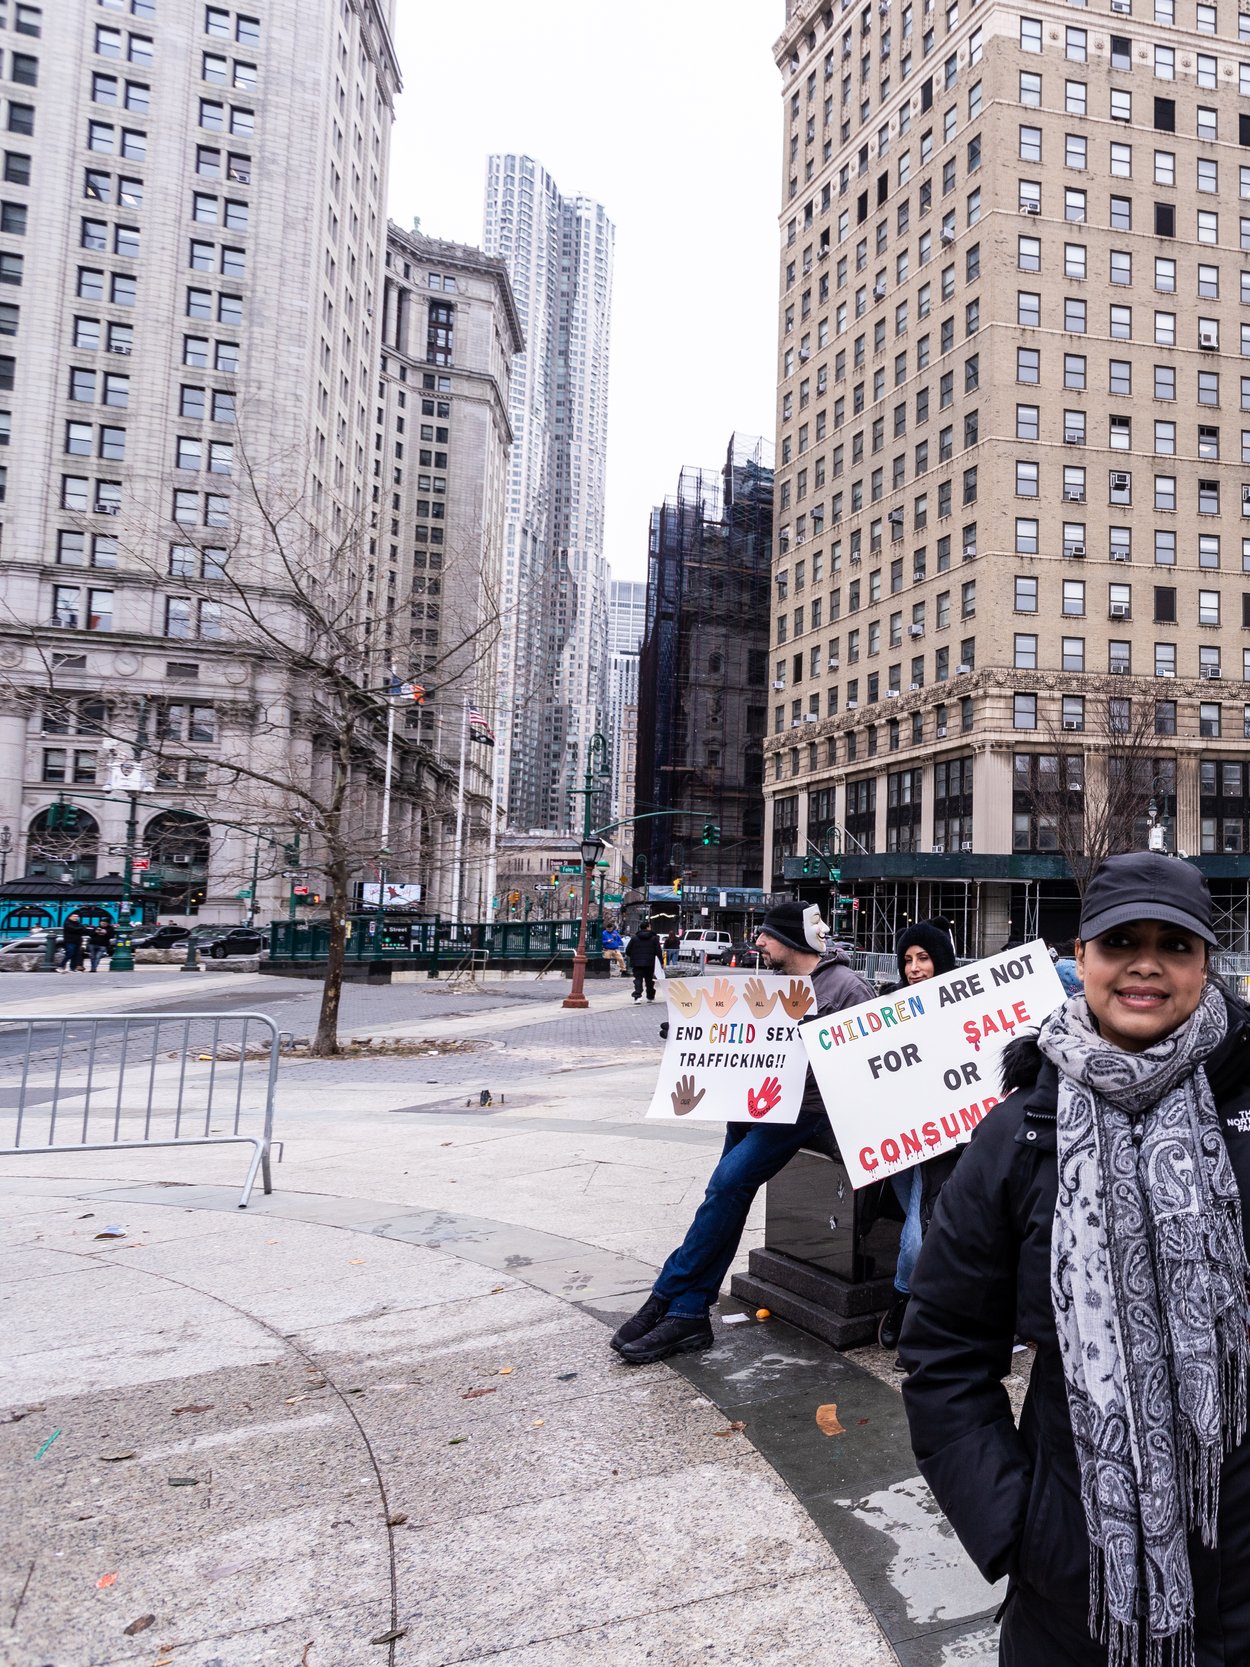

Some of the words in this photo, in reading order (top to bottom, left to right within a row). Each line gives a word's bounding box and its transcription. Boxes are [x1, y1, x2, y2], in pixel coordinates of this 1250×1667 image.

[818, 994, 925, 1051] CHILDREN
[937, 973, 986, 1009] ARE
[991, 954, 1036, 988] NOT
[676, 1026, 703, 1041] END
[709, 1023, 756, 1044] CHILD
[766, 1026, 803, 1042] SEX
[867, 1043, 922, 1080] FOR
[963, 1000, 1031, 1046] SALE
[679, 1053, 786, 1069] TRAFFICKING!!
[943, 1061, 982, 1091] OR
[859, 1096, 1006, 1172] CONSUMP
